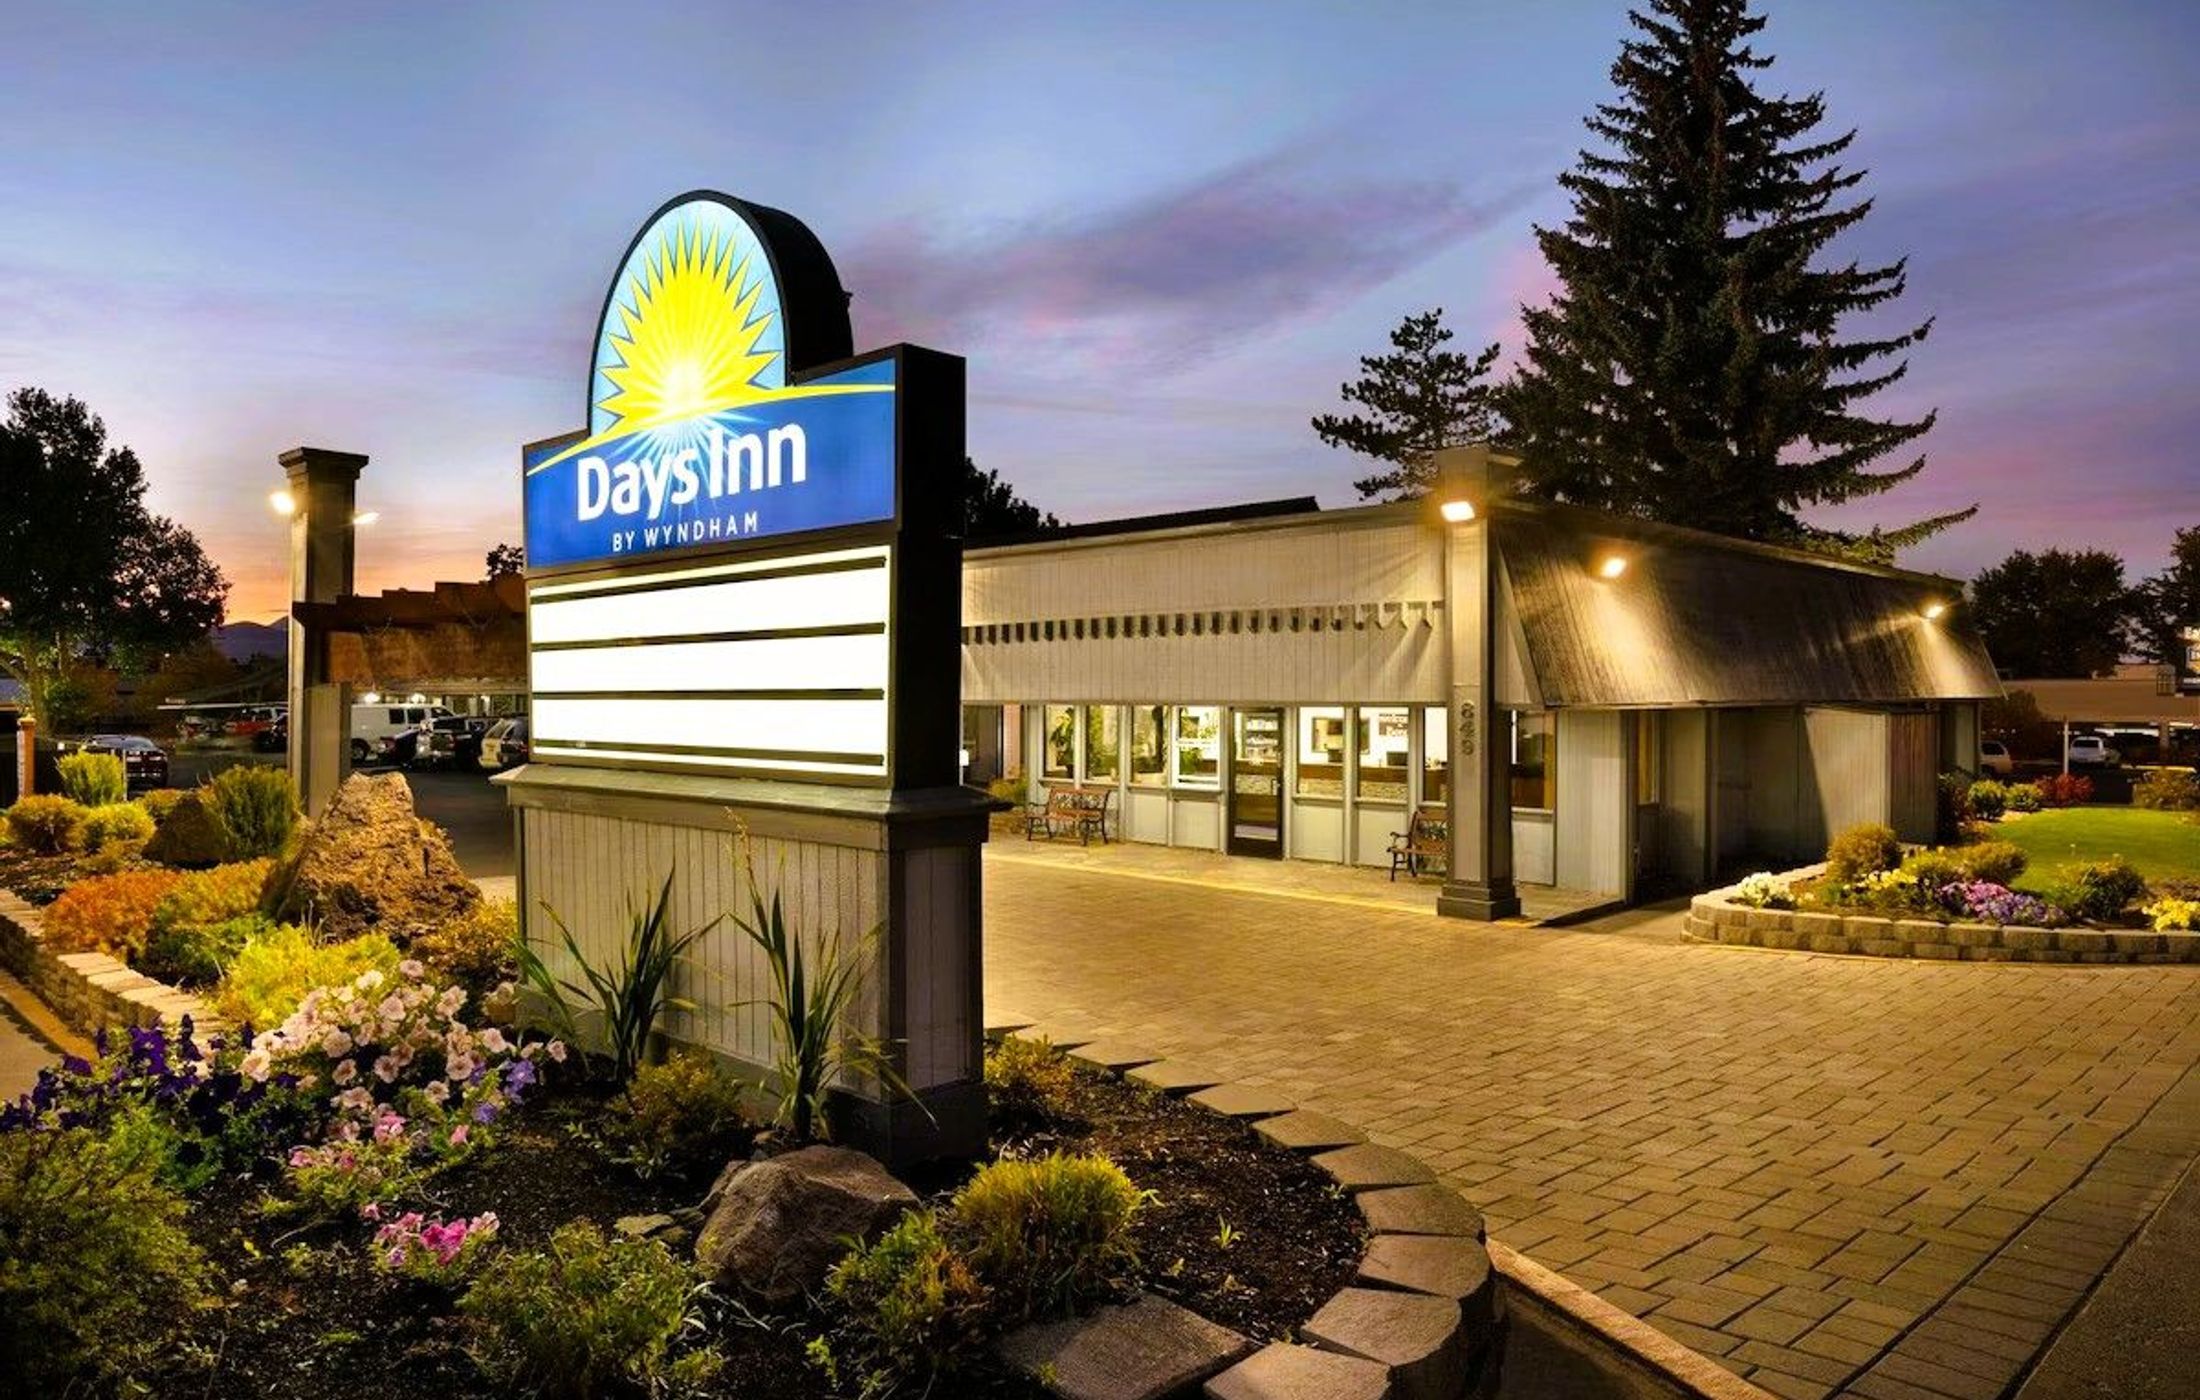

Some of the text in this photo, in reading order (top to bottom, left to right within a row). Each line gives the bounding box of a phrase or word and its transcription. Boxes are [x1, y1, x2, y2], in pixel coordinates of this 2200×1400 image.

[577, 423, 806, 522] Days Inn
[612, 511, 758, 552] BY WYNDHAM
